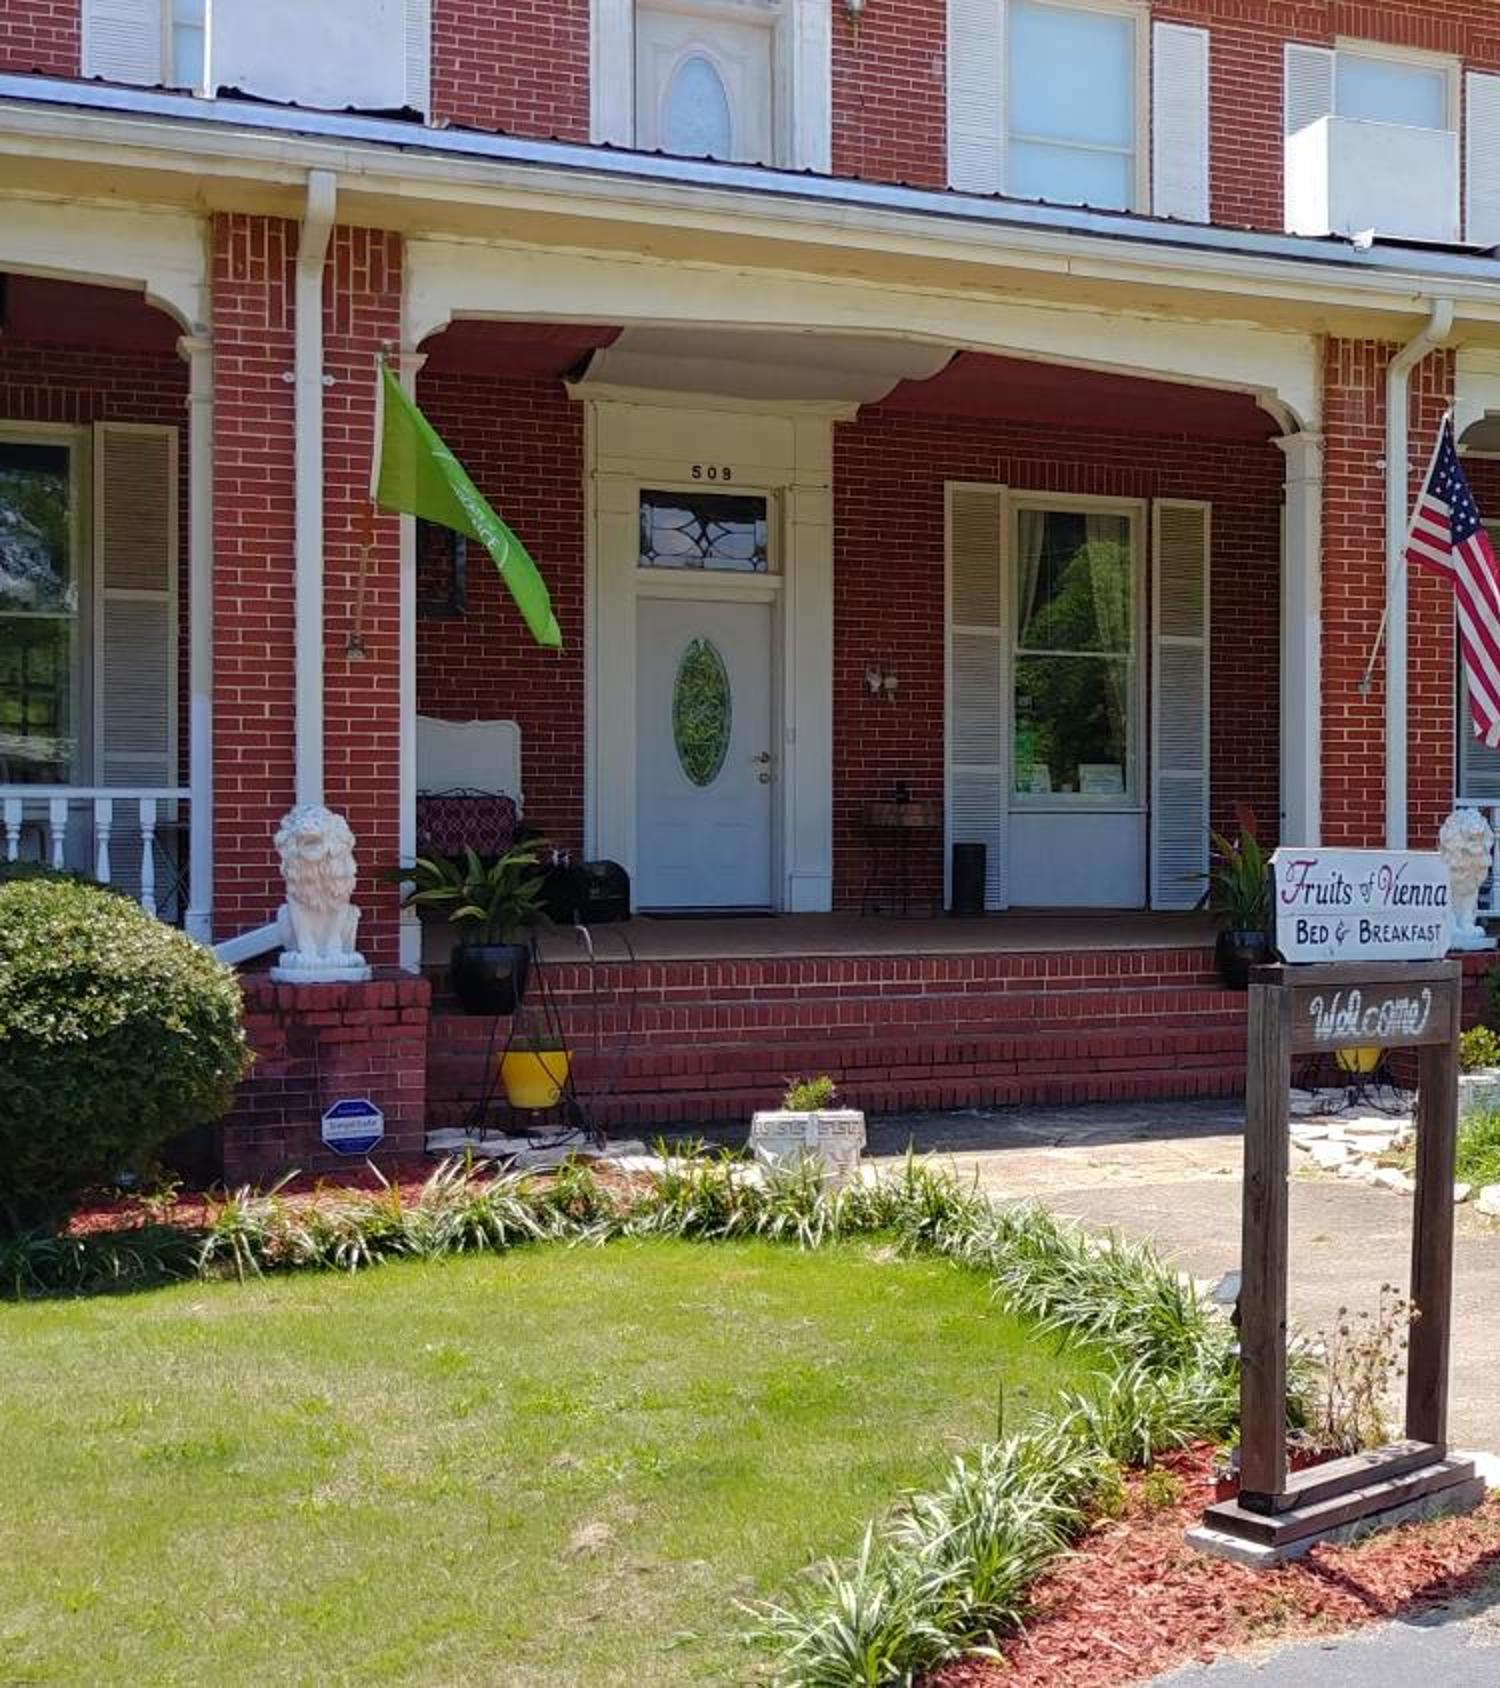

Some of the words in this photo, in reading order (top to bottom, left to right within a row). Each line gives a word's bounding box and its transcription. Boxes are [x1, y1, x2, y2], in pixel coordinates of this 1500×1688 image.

[691, 465, 732, 481] 509
[1281, 859, 1352, 904] Fruits
[1358, 871, 1376, 903] of
[1378, 861, 1448, 907] Vienna
[1296, 919, 1329, 945] BED
[1359, 919, 1442, 944] BREAKFAST
[1310, 987, 1432, 1039] Welcome
